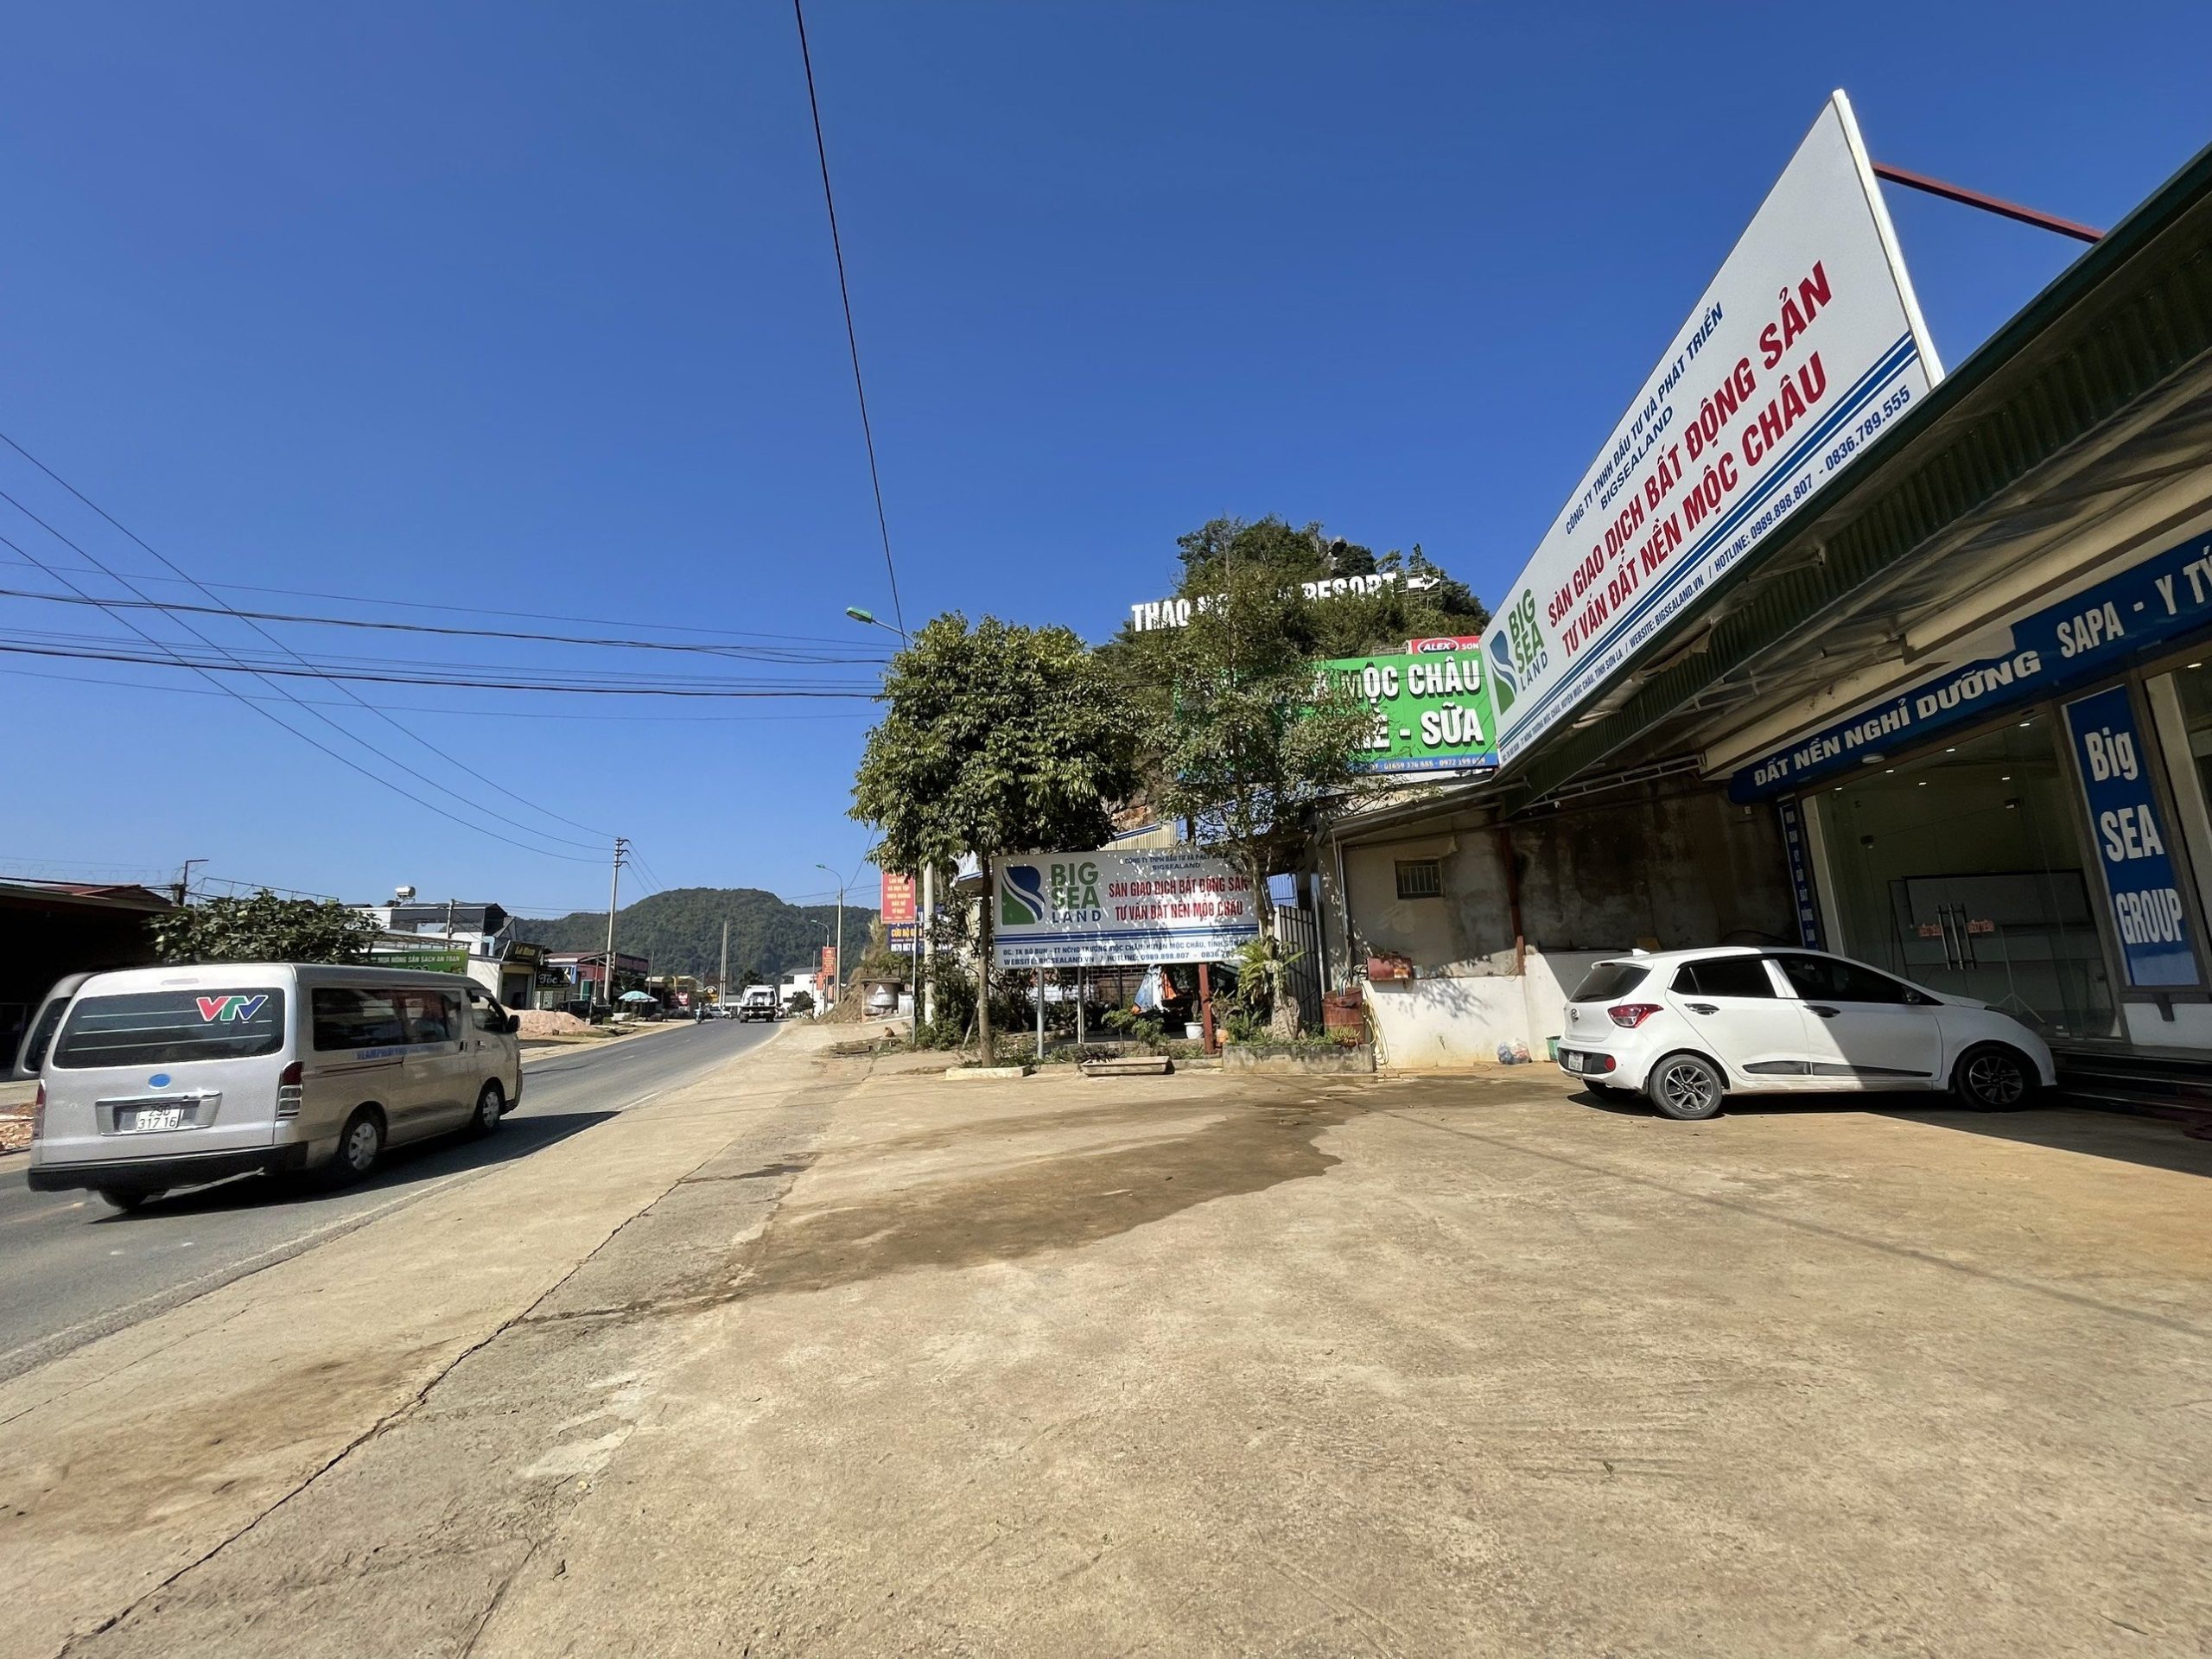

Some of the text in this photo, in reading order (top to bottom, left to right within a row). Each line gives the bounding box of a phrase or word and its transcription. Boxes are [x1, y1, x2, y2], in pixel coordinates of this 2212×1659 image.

[1566, 302, 1724, 535] CÔNG TY TNHH ĐẦU TƯ VÀ PHÁT TRIỂN
[1548, 259, 1832, 628] SÀN GIAO DỊCH BẤT ĐỘNG SẢN
[1601, 405, 1674, 511] BIGSEALAND
[1561, 350, 1827, 658] TƯ VẤN ĐẤT NỀN MỘC CHÂU
[1629, 619, 1656, 648] WEBSITE:
[1655, 575, 1705, 626] BIGSEALAND.VN
[1714, 534, 1751, 572] HOTLINE:
[1750, 474, 1814, 540] 0989.898.807
[1825, 384, 1910, 472] 0836.789.555
[1508, 588, 1535, 645] BIG
[1423, 642, 1451, 652] ALEX
[1515, 620, 1545, 674] SEA
[1408, 655, 1482, 698] CHÂU
[1520, 651, 1548, 691] LAND
[1754, 754, 1789, 786] ĐẤT
[1794, 735, 1841, 770] NỀN
[1844, 697, 1911, 749] NGHỈ
[1916, 650, 2042, 720] DƯỠNG
[2056, 601, 2125, 658] SAPA
[2154, 574, 2177, 616] Y
[1421, 701, 1485, 746] SỮA
[2084, 726, 2139, 782] Big
[2100, 804, 2165, 862] SEA
[1051, 862, 1099, 887] BIG
[1109, 880, 1128, 898] SÀN
[1130, 880, 1152, 896] GIAO
[1179, 874, 1196, 894] BẤT
[1152, 862, 1201, 871] BIGSEALAND
[1052, 886, 1103, 910] SEA
[1052, 910, 1102, 925] LAND
[1116, 905, 1127, 921] TƯ
[1129, 900, 1148, 921] VẤN
[1217, 898, 1243, 916] CHÂU
[2116, 887, 2183, 945] GROUP
[1004, 957, 1037, 965] WEBSITE:
[196, 995, 269, 1021] VTV
